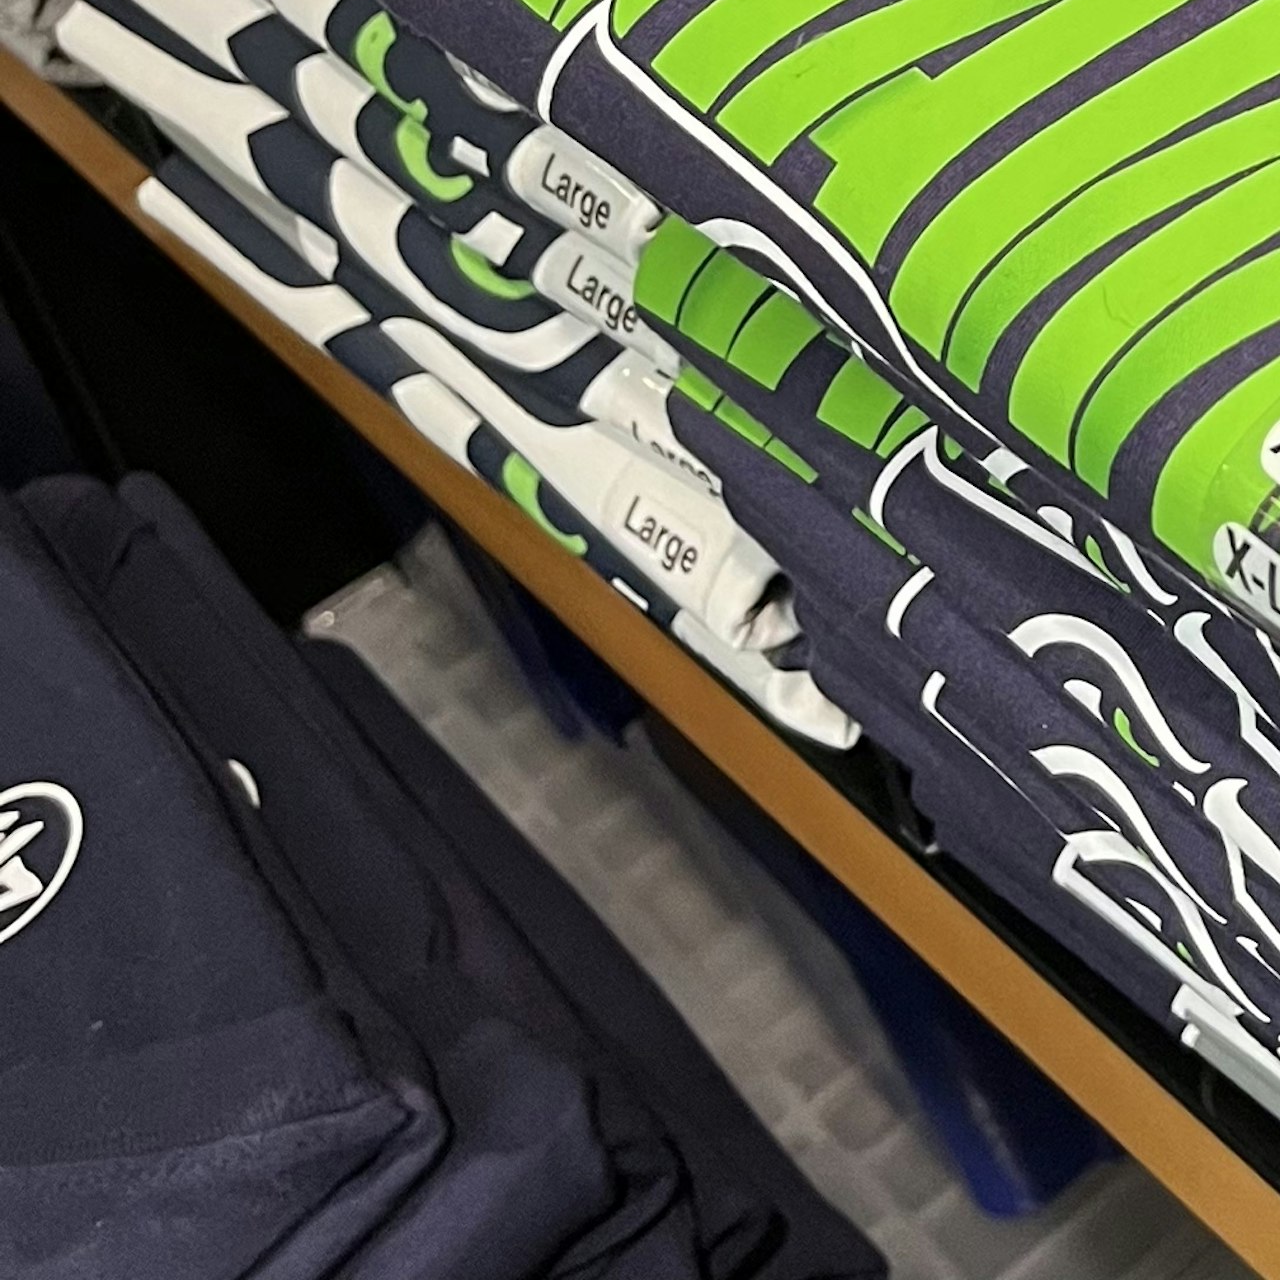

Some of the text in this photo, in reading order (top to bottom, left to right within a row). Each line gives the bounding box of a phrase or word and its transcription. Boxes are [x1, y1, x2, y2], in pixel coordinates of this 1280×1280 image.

[540, 153, 612, 231] Large
[565, 255, 640, 334] Large
[623, 496, 698, 574] Large
